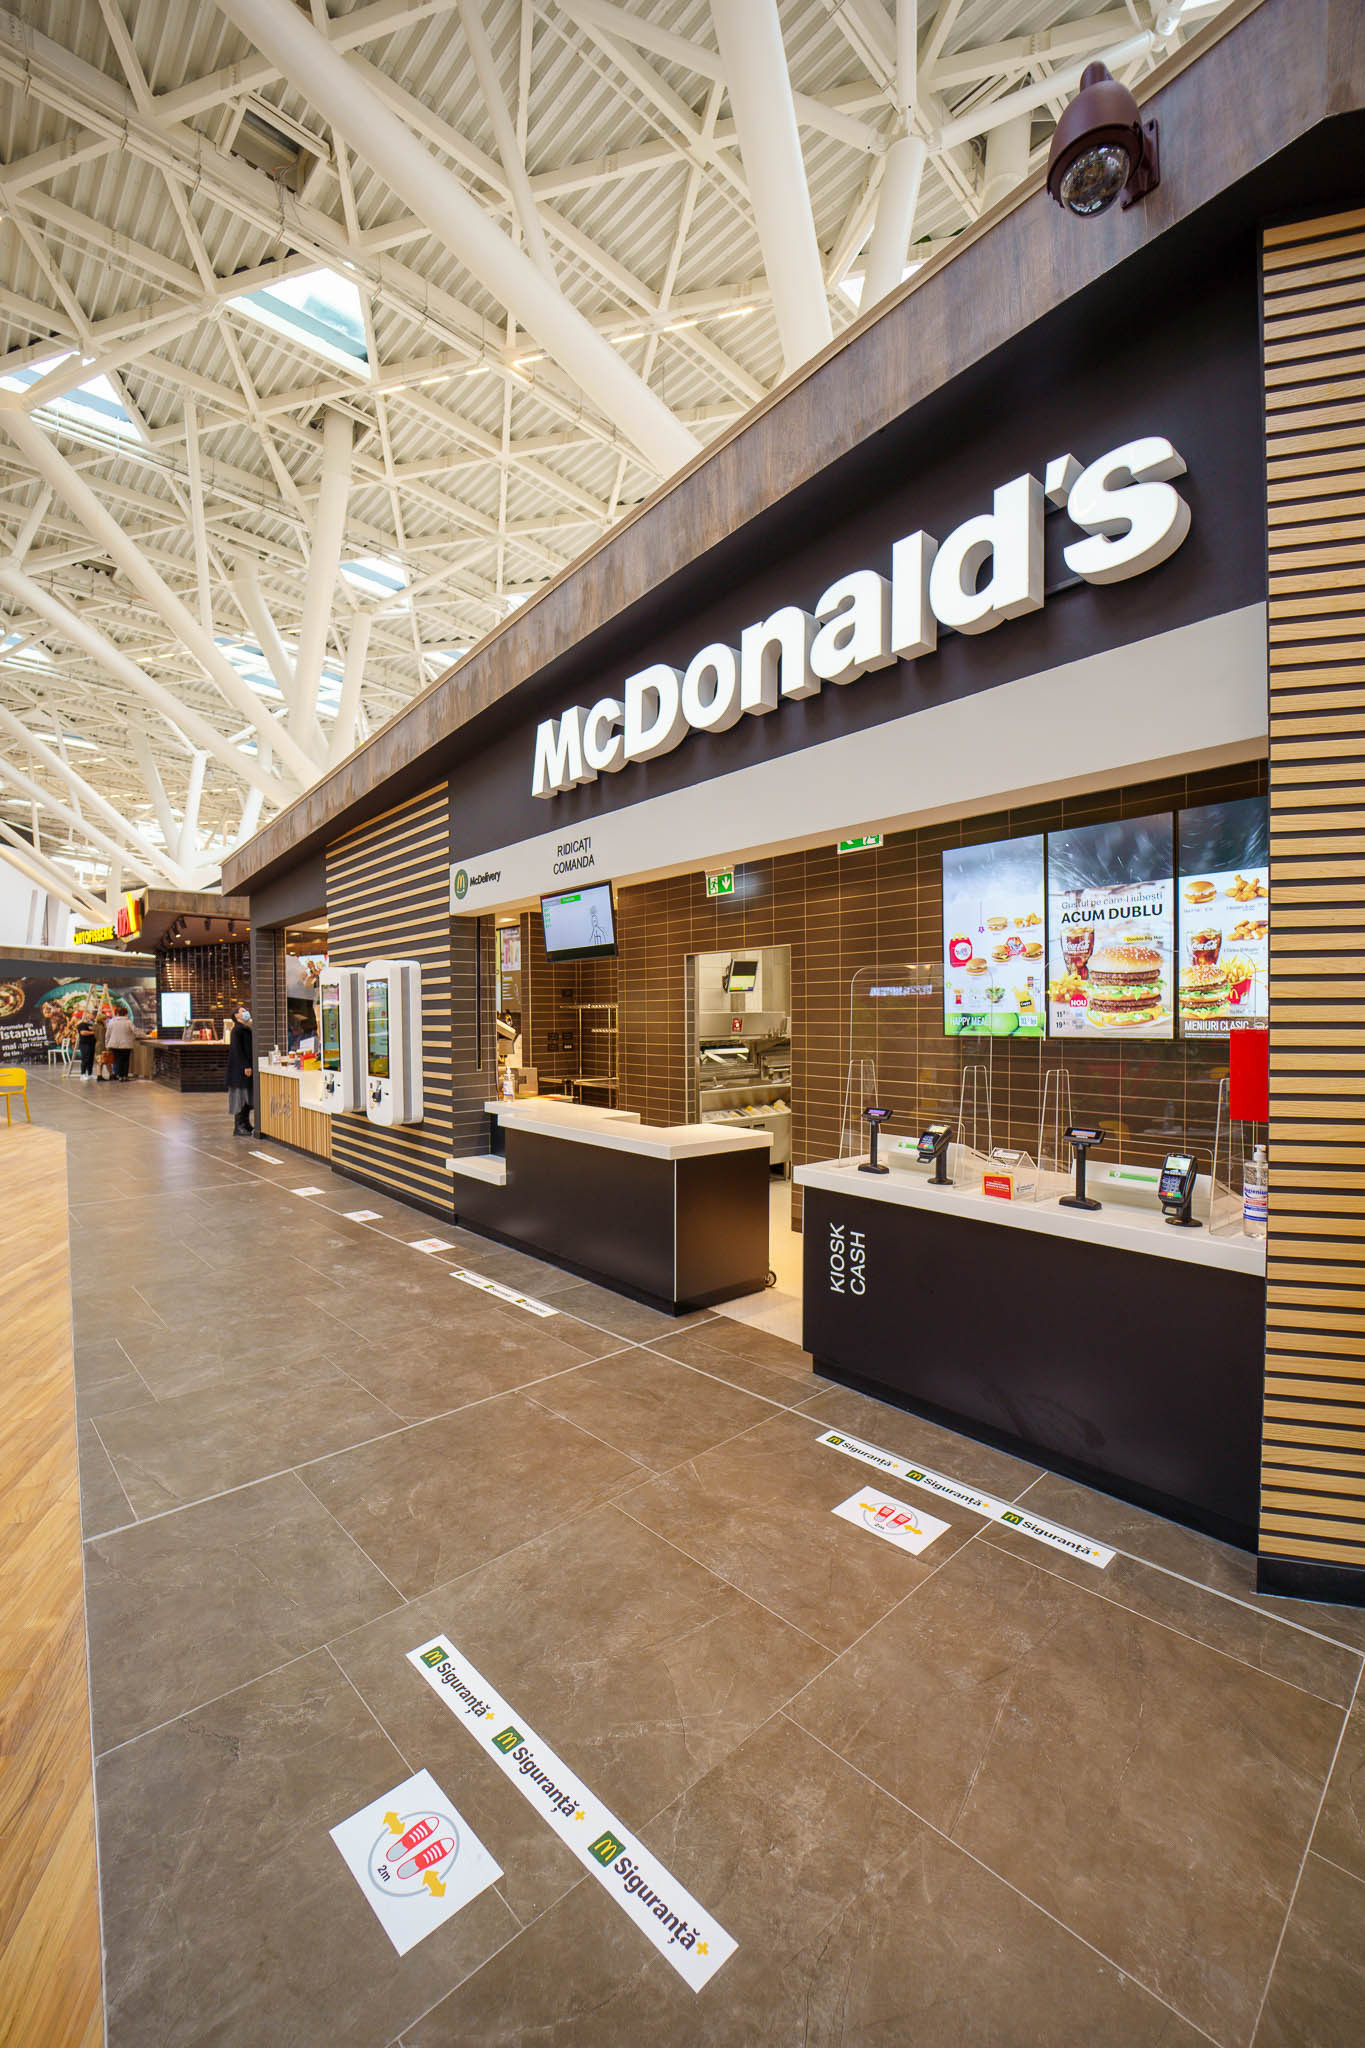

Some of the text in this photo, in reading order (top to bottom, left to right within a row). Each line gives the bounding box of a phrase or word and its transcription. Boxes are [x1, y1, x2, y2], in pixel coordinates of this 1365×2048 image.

[531, 436, 1191, 800] McDonald's
[553, 854, 595, 875] COMANDA
[469, 870, 502, 888] McDelivery
[1061, 903, 1163, 924] ACUM DUBLU
[0, 1025, 47, 1040] Istanbul
[1184, 1020, 1219, 1031] MENIURI
[829, 1222, 845, 1294] KIOSK
[850, 1231, 866, 1296] CASH
[377, 1864, 391, 1882] 2m
